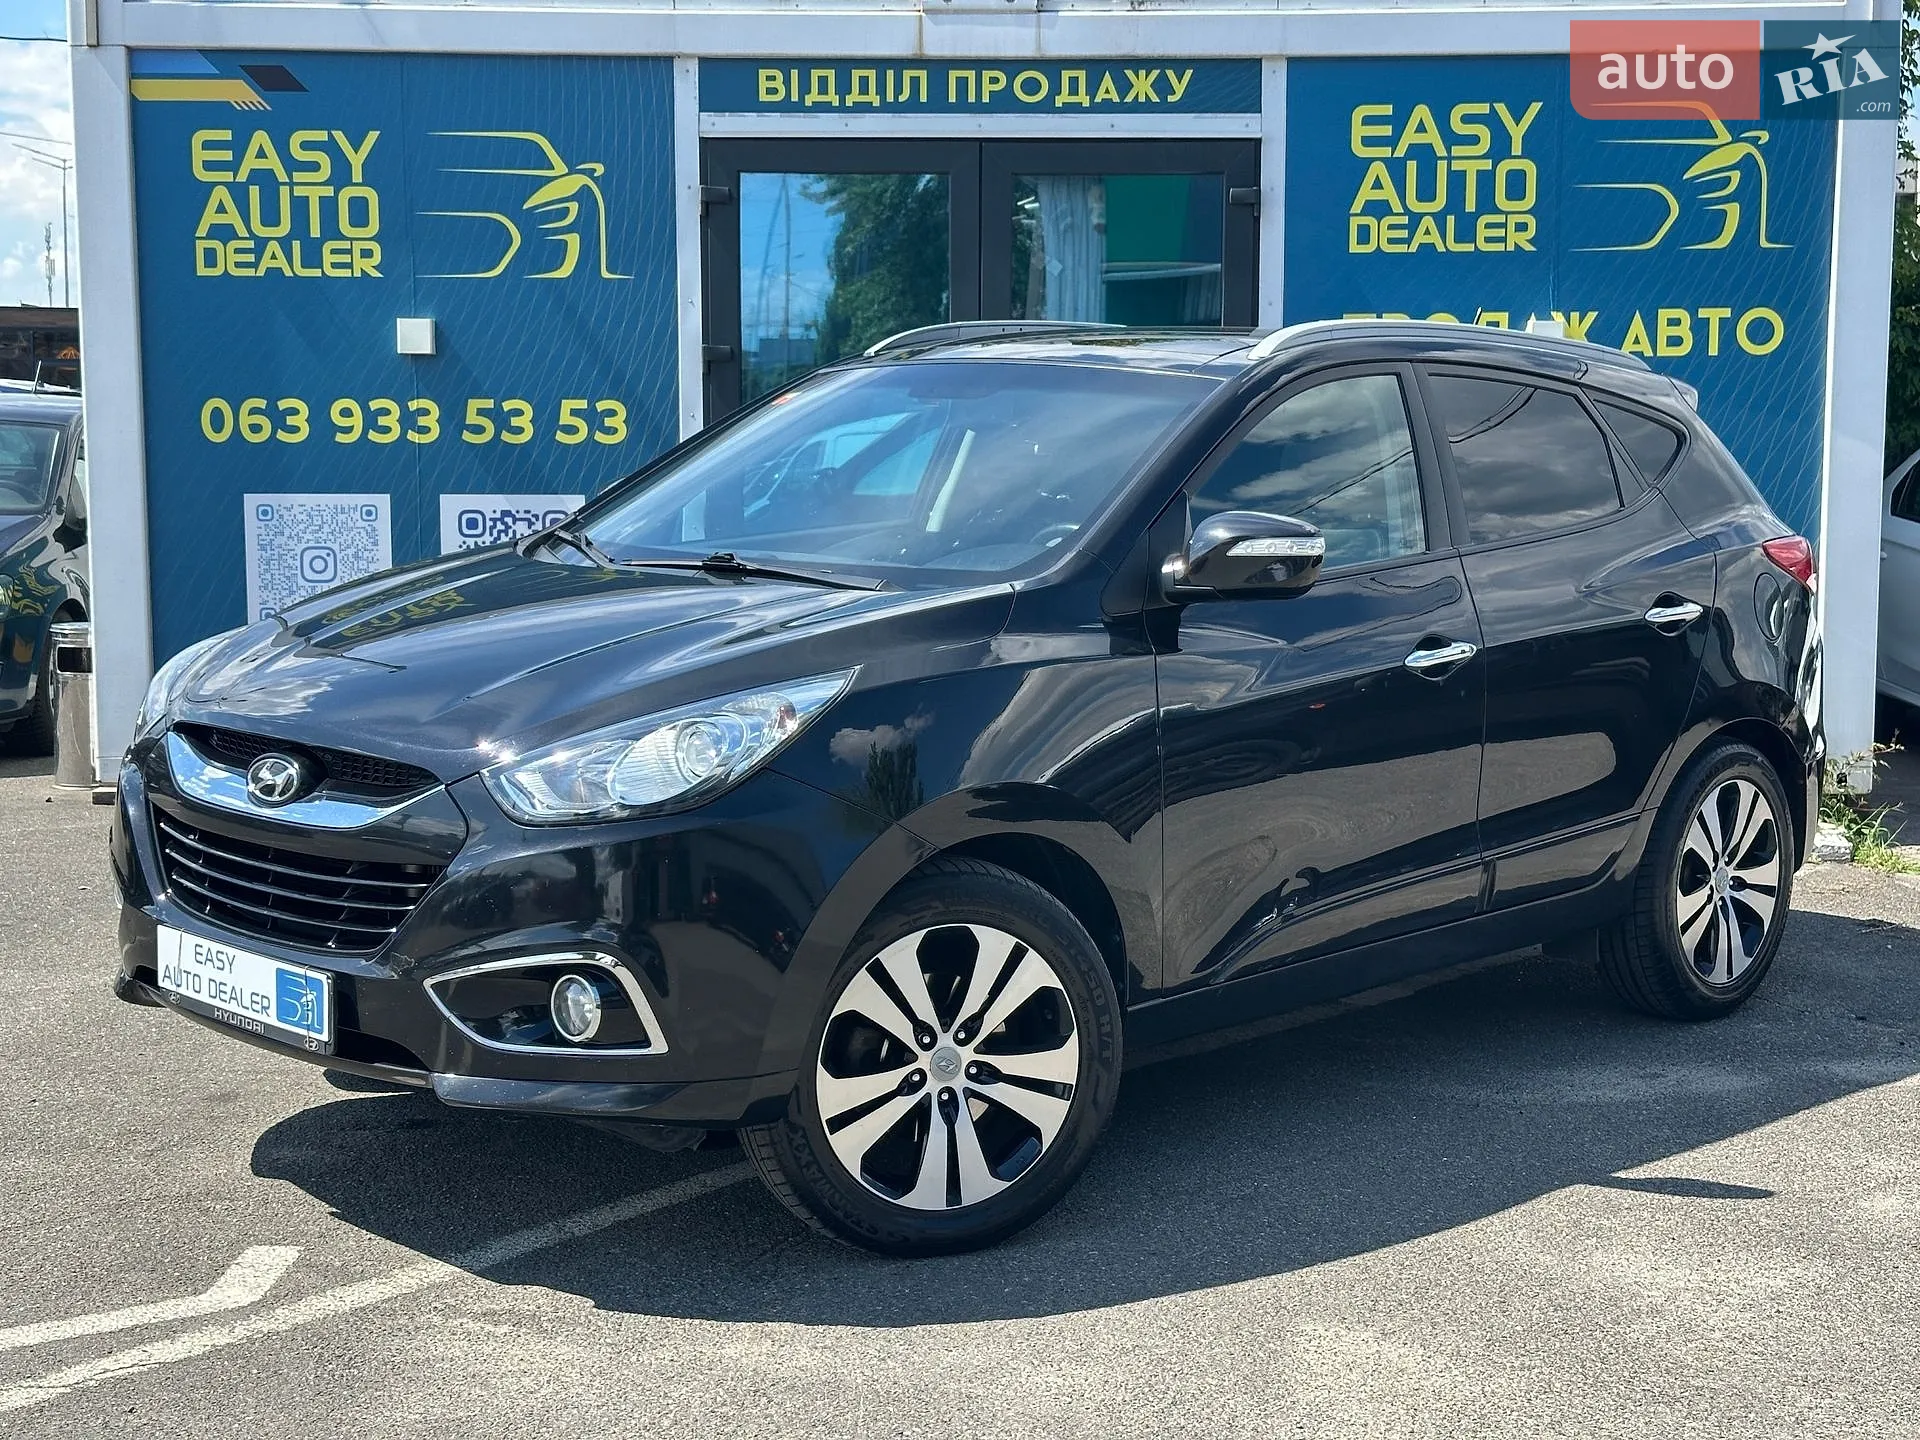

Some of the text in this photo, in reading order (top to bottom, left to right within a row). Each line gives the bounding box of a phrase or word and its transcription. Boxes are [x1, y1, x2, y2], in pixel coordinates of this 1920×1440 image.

[757, 68, 1194, 108] ВІДДІЛ ПРОДАЖУ
[1350, 102, 1543, 159] EASY
[191, 129, 380, 183] EASY
[1350, 159, 1537, 214] AUTO
[195, 185, 380, 239] AUTO
[1348, 214, 1537, 253] DEALER
[195, 239, 383, 278] DEALER
[1620, 306, 1785, 357] АВТО
[201, 397, 628, 444] 063 933 53 53
[194, 943, 236, 974] EASY
[162, 964, 273, 1018] AUTO DEALER
[214, 1008, 265, 1035] HYUNDAI
